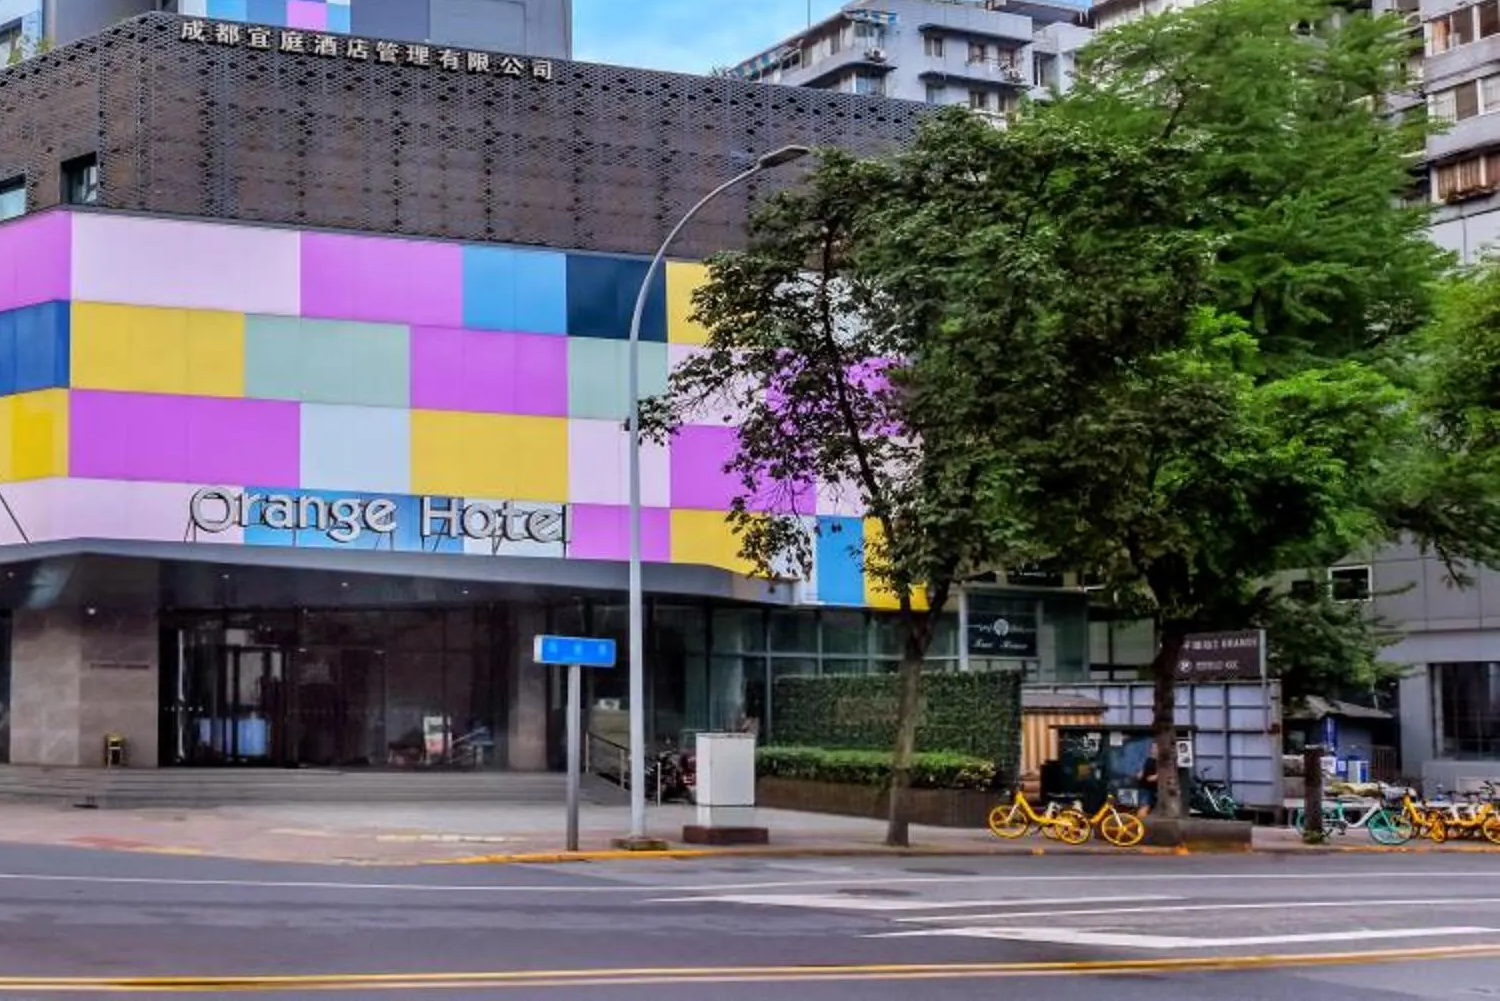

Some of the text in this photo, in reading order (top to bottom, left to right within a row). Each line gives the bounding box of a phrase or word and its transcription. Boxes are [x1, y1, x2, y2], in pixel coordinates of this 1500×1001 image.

[180, 20, 554, 81] 成都宜庭酒店管理有限公司
[190, 485, 573, 543] Orange Hotel
